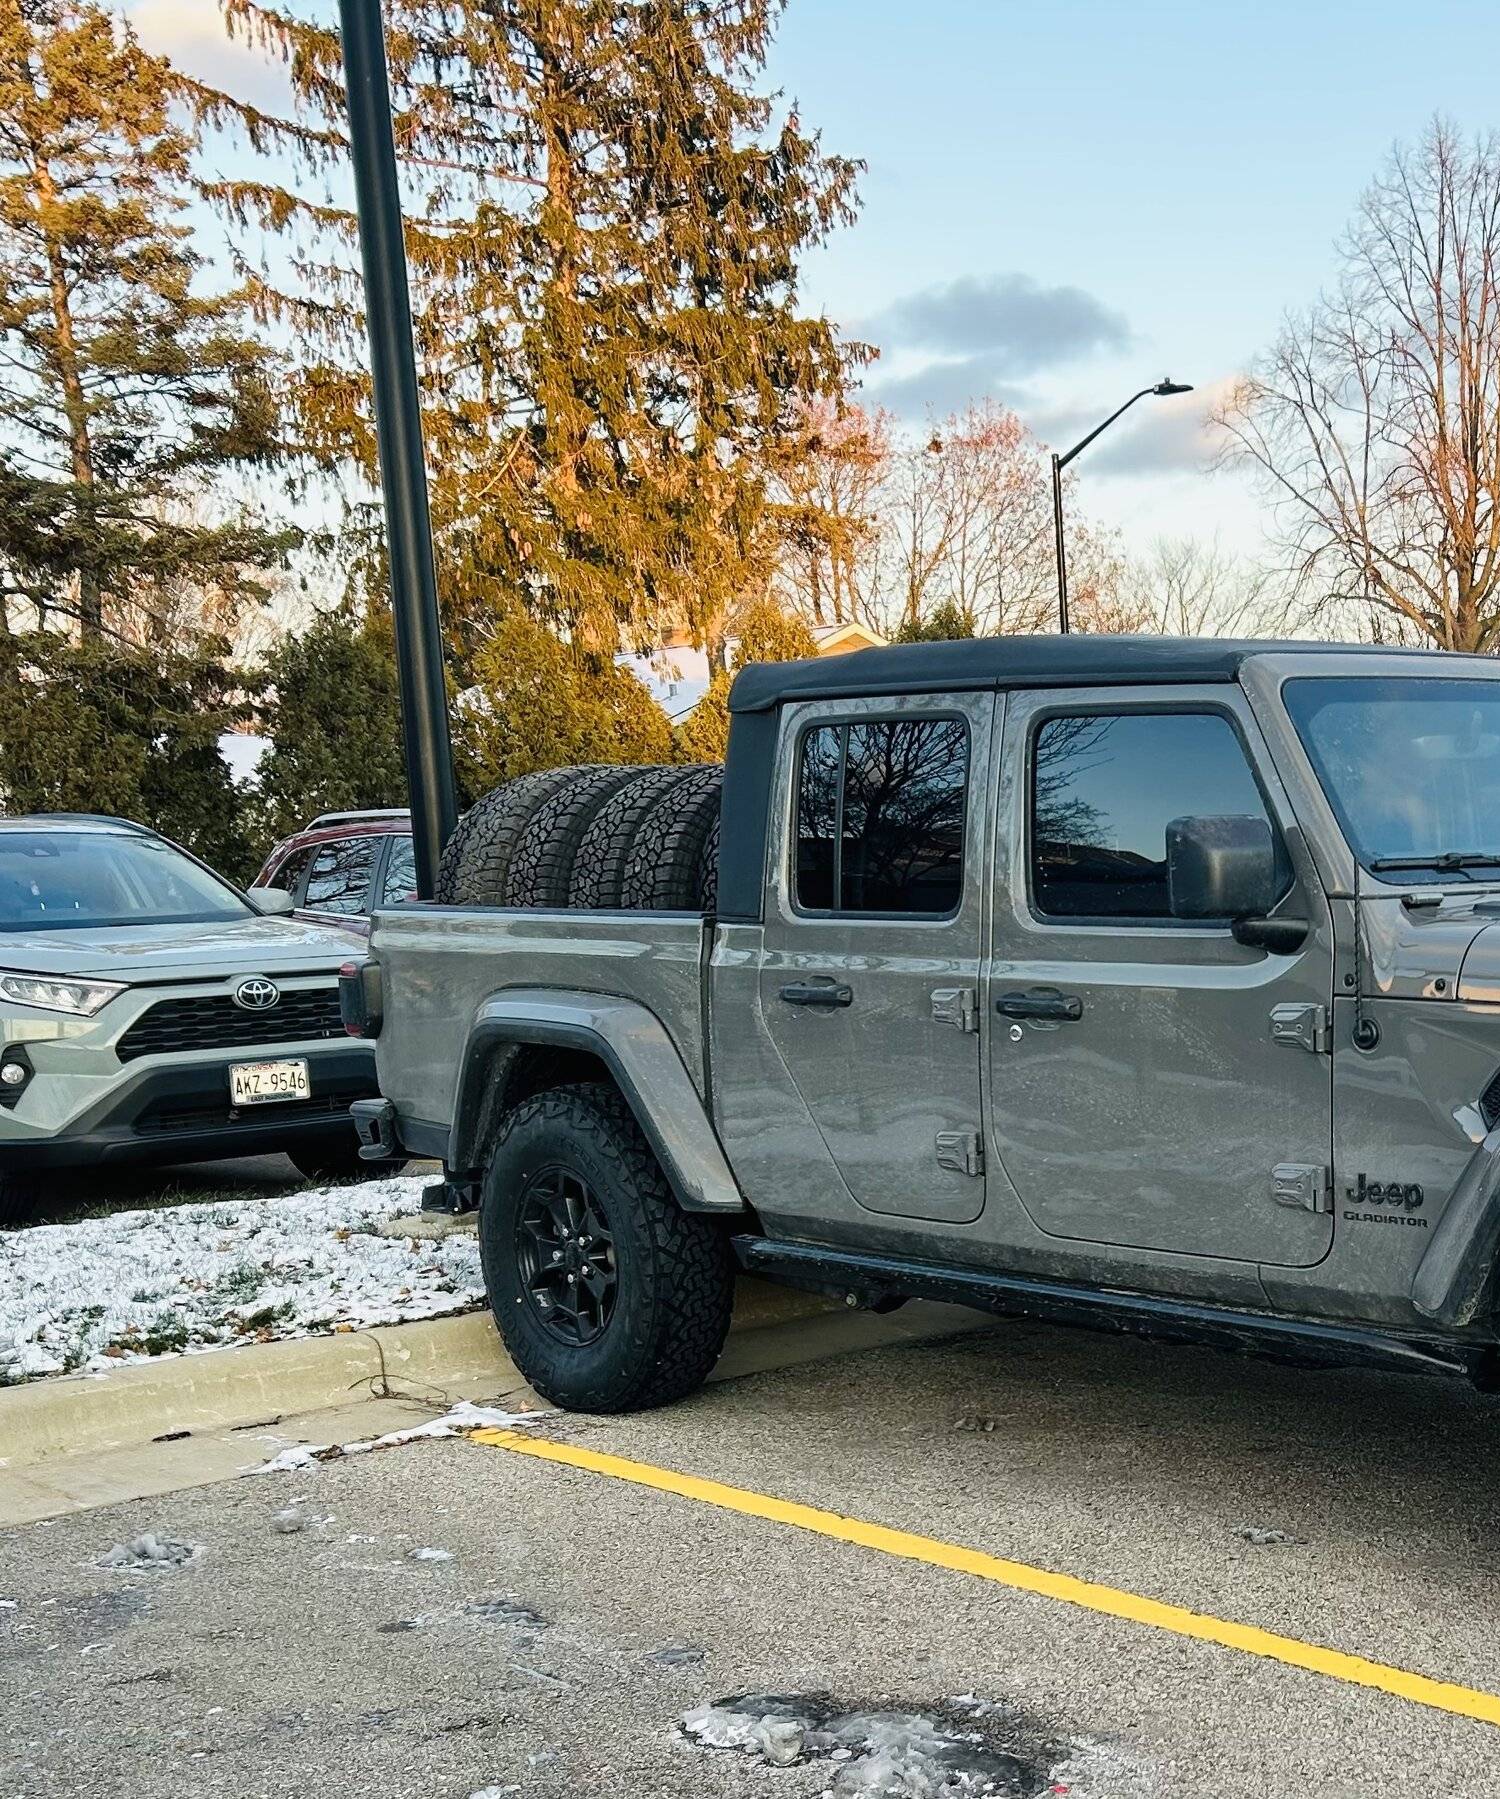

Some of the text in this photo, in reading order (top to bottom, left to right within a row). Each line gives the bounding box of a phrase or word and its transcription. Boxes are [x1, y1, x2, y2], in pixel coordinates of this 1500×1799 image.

[235, 1071, 306, 1095] AKZ-9546
[1345, 1172, 1425, 1214] Jeep
[1343, 1210, 1429, 1229] GLADIATOR
